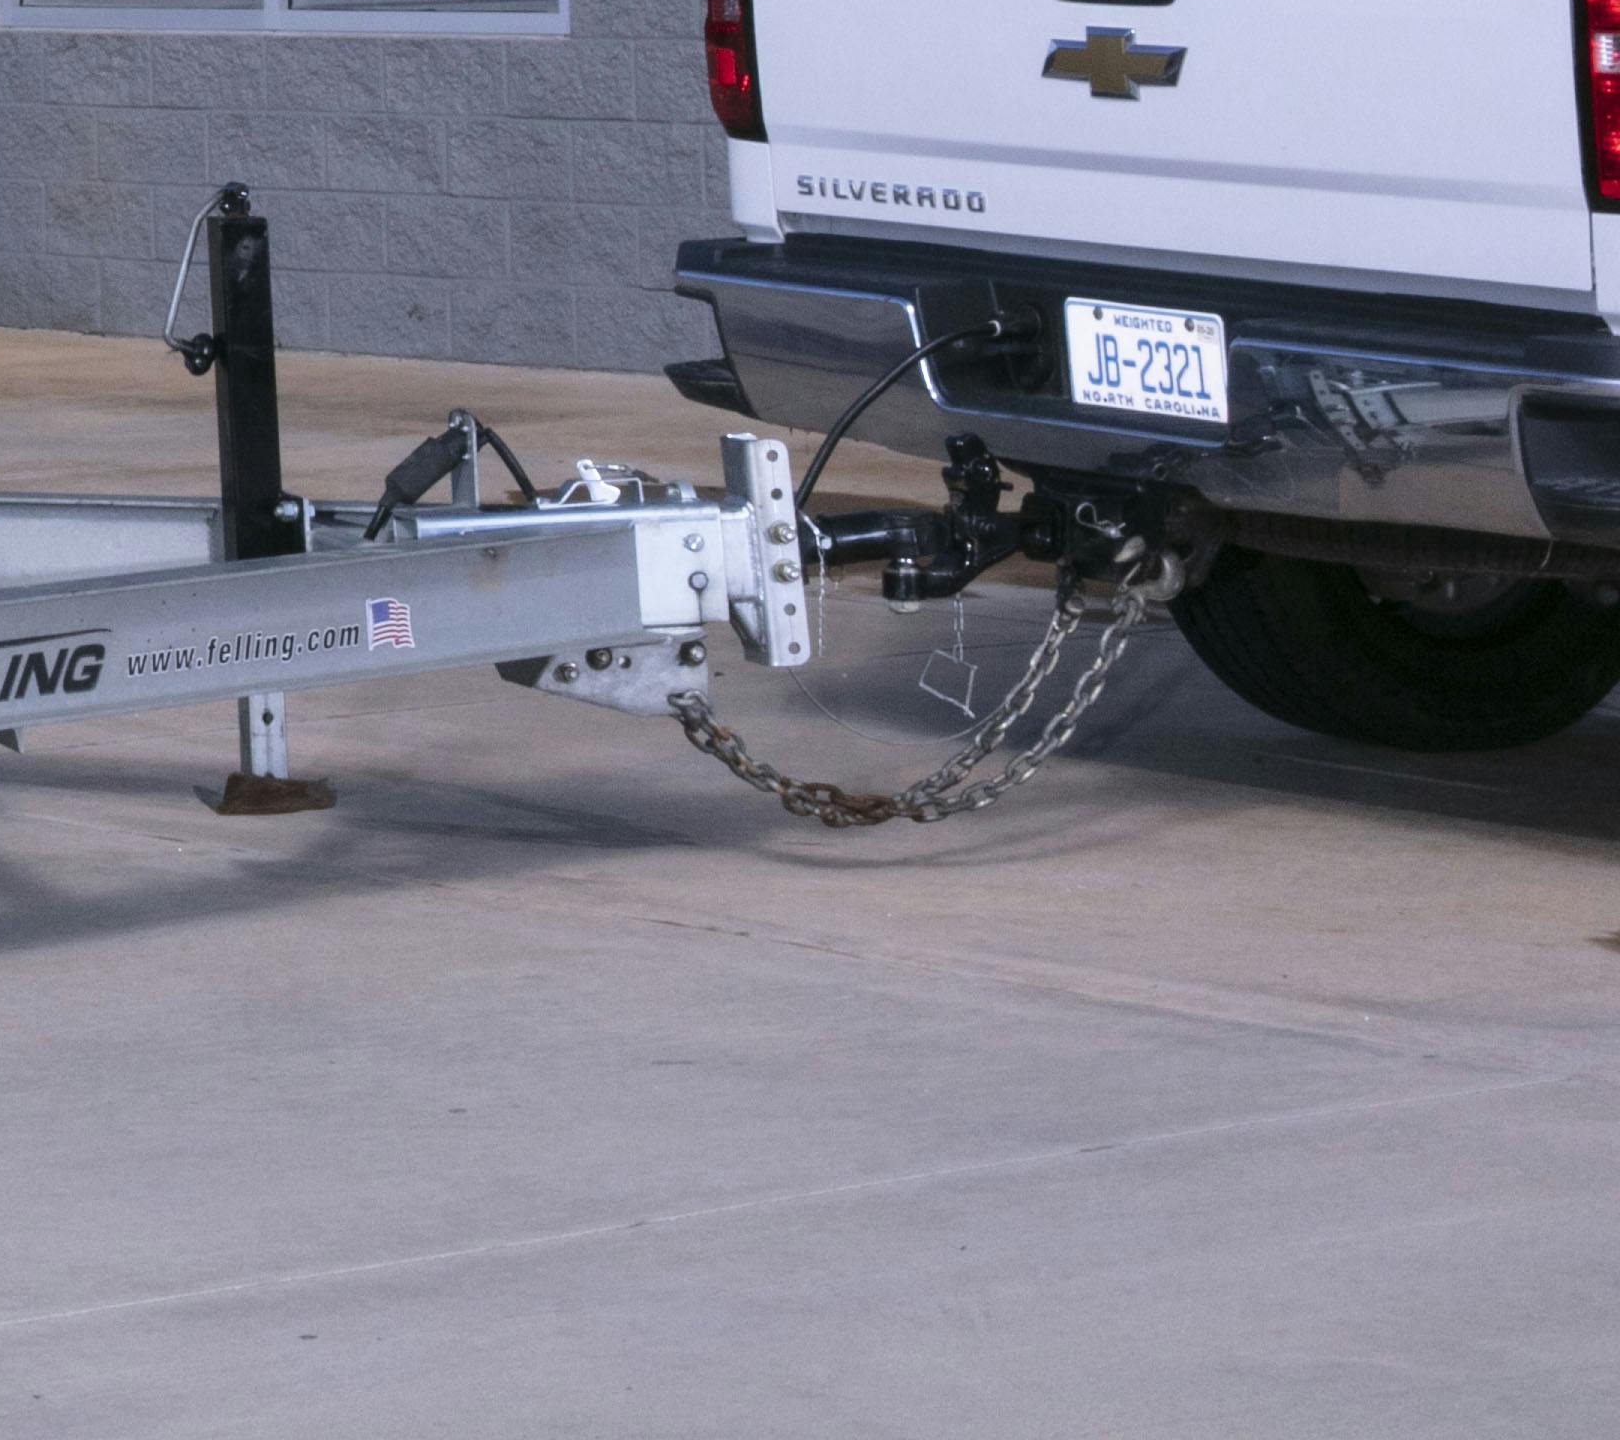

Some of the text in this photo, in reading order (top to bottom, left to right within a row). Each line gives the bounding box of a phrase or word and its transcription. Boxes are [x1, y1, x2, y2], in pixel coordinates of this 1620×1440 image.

[796, 174, 987, 214] SILVERADO
[1114, 315, 1173, 333] WEIGHTED
[1088, 332, 1212, 401] JB-2321
[1083, 390, 1221, 419] NORTH CAROLINA
[126, 622, 361, 678] www.felling.com
